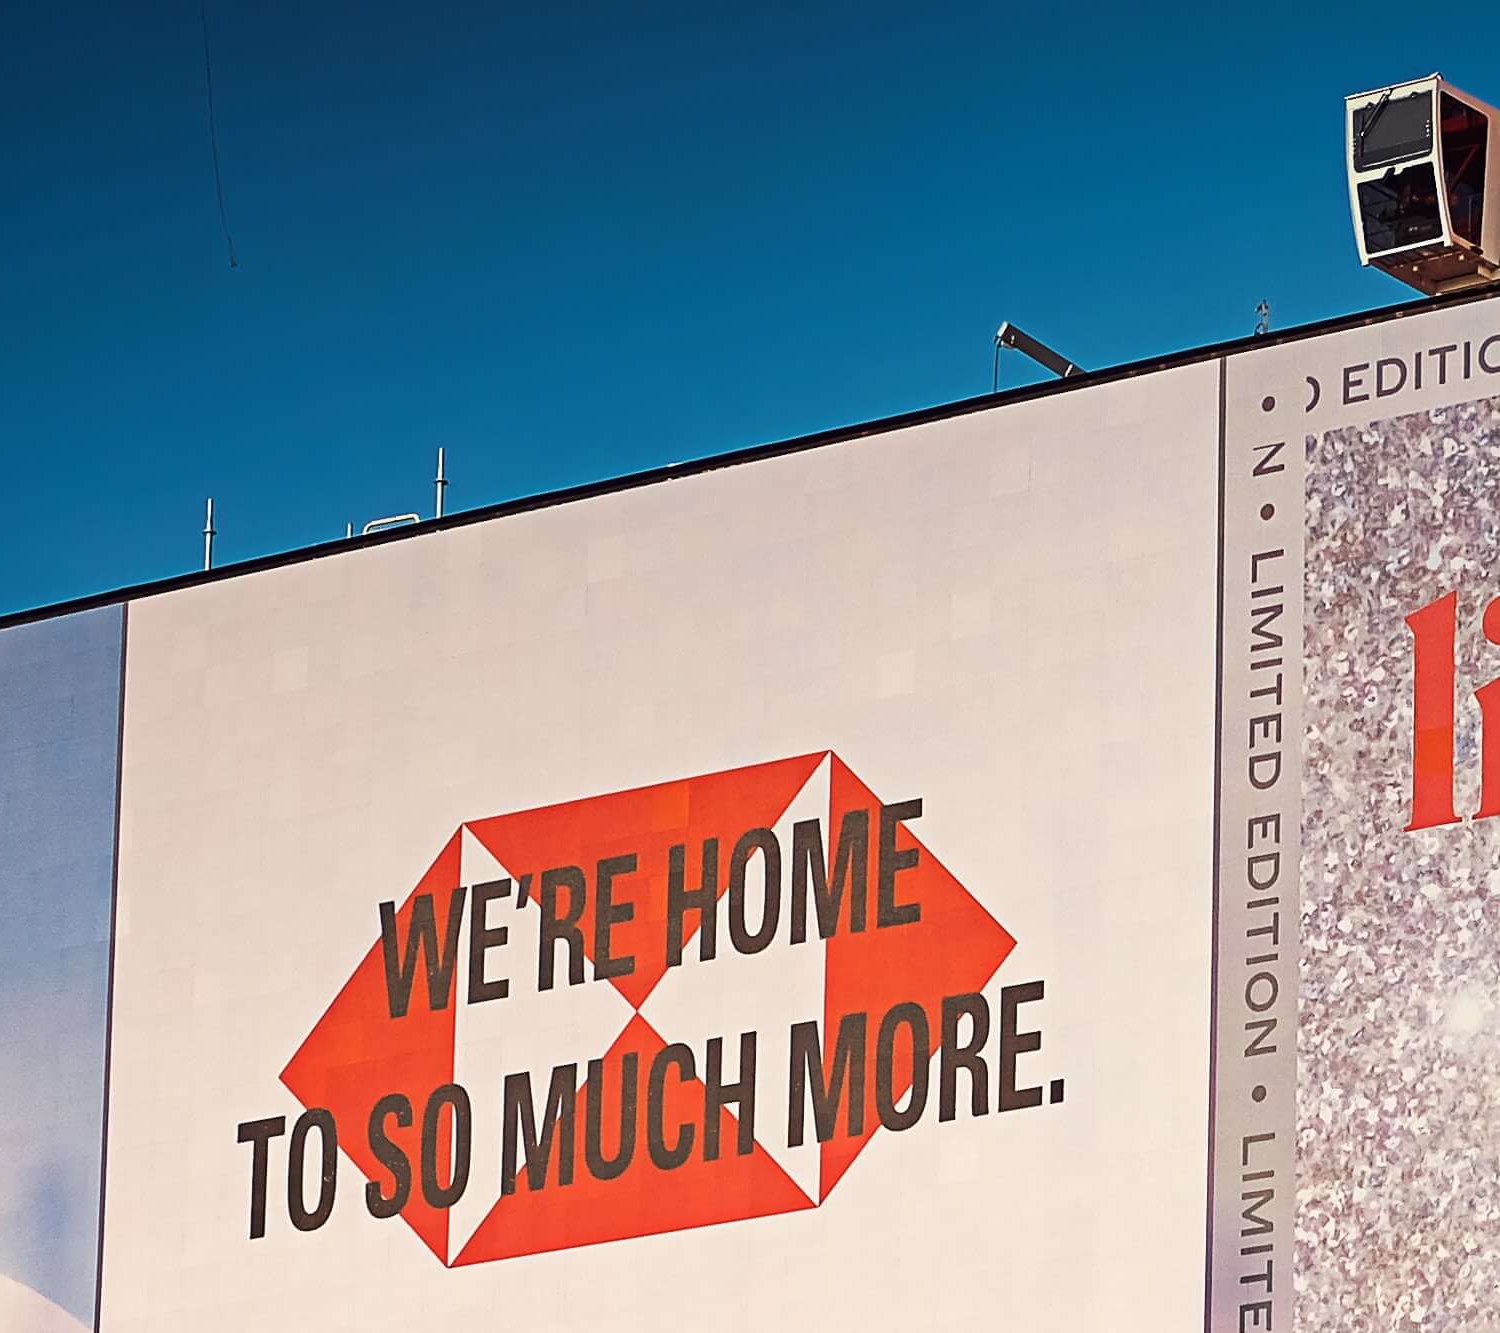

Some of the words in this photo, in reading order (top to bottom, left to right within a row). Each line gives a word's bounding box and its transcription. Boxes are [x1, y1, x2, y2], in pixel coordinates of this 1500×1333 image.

[1247, 548, 1285, 791] LIMITED
[378, 851, 637, 1020] WE'RE
[665, 797, 924, 970] HOME
[1243, 813, 1281, 1059] EDITION
[236, 1107, 338, 1241] TO
[364, 1083, 471, 1220] SO
[501, 1031, 758, 1198] MUCH
[786, 980, 1065, 1150] MORE.
